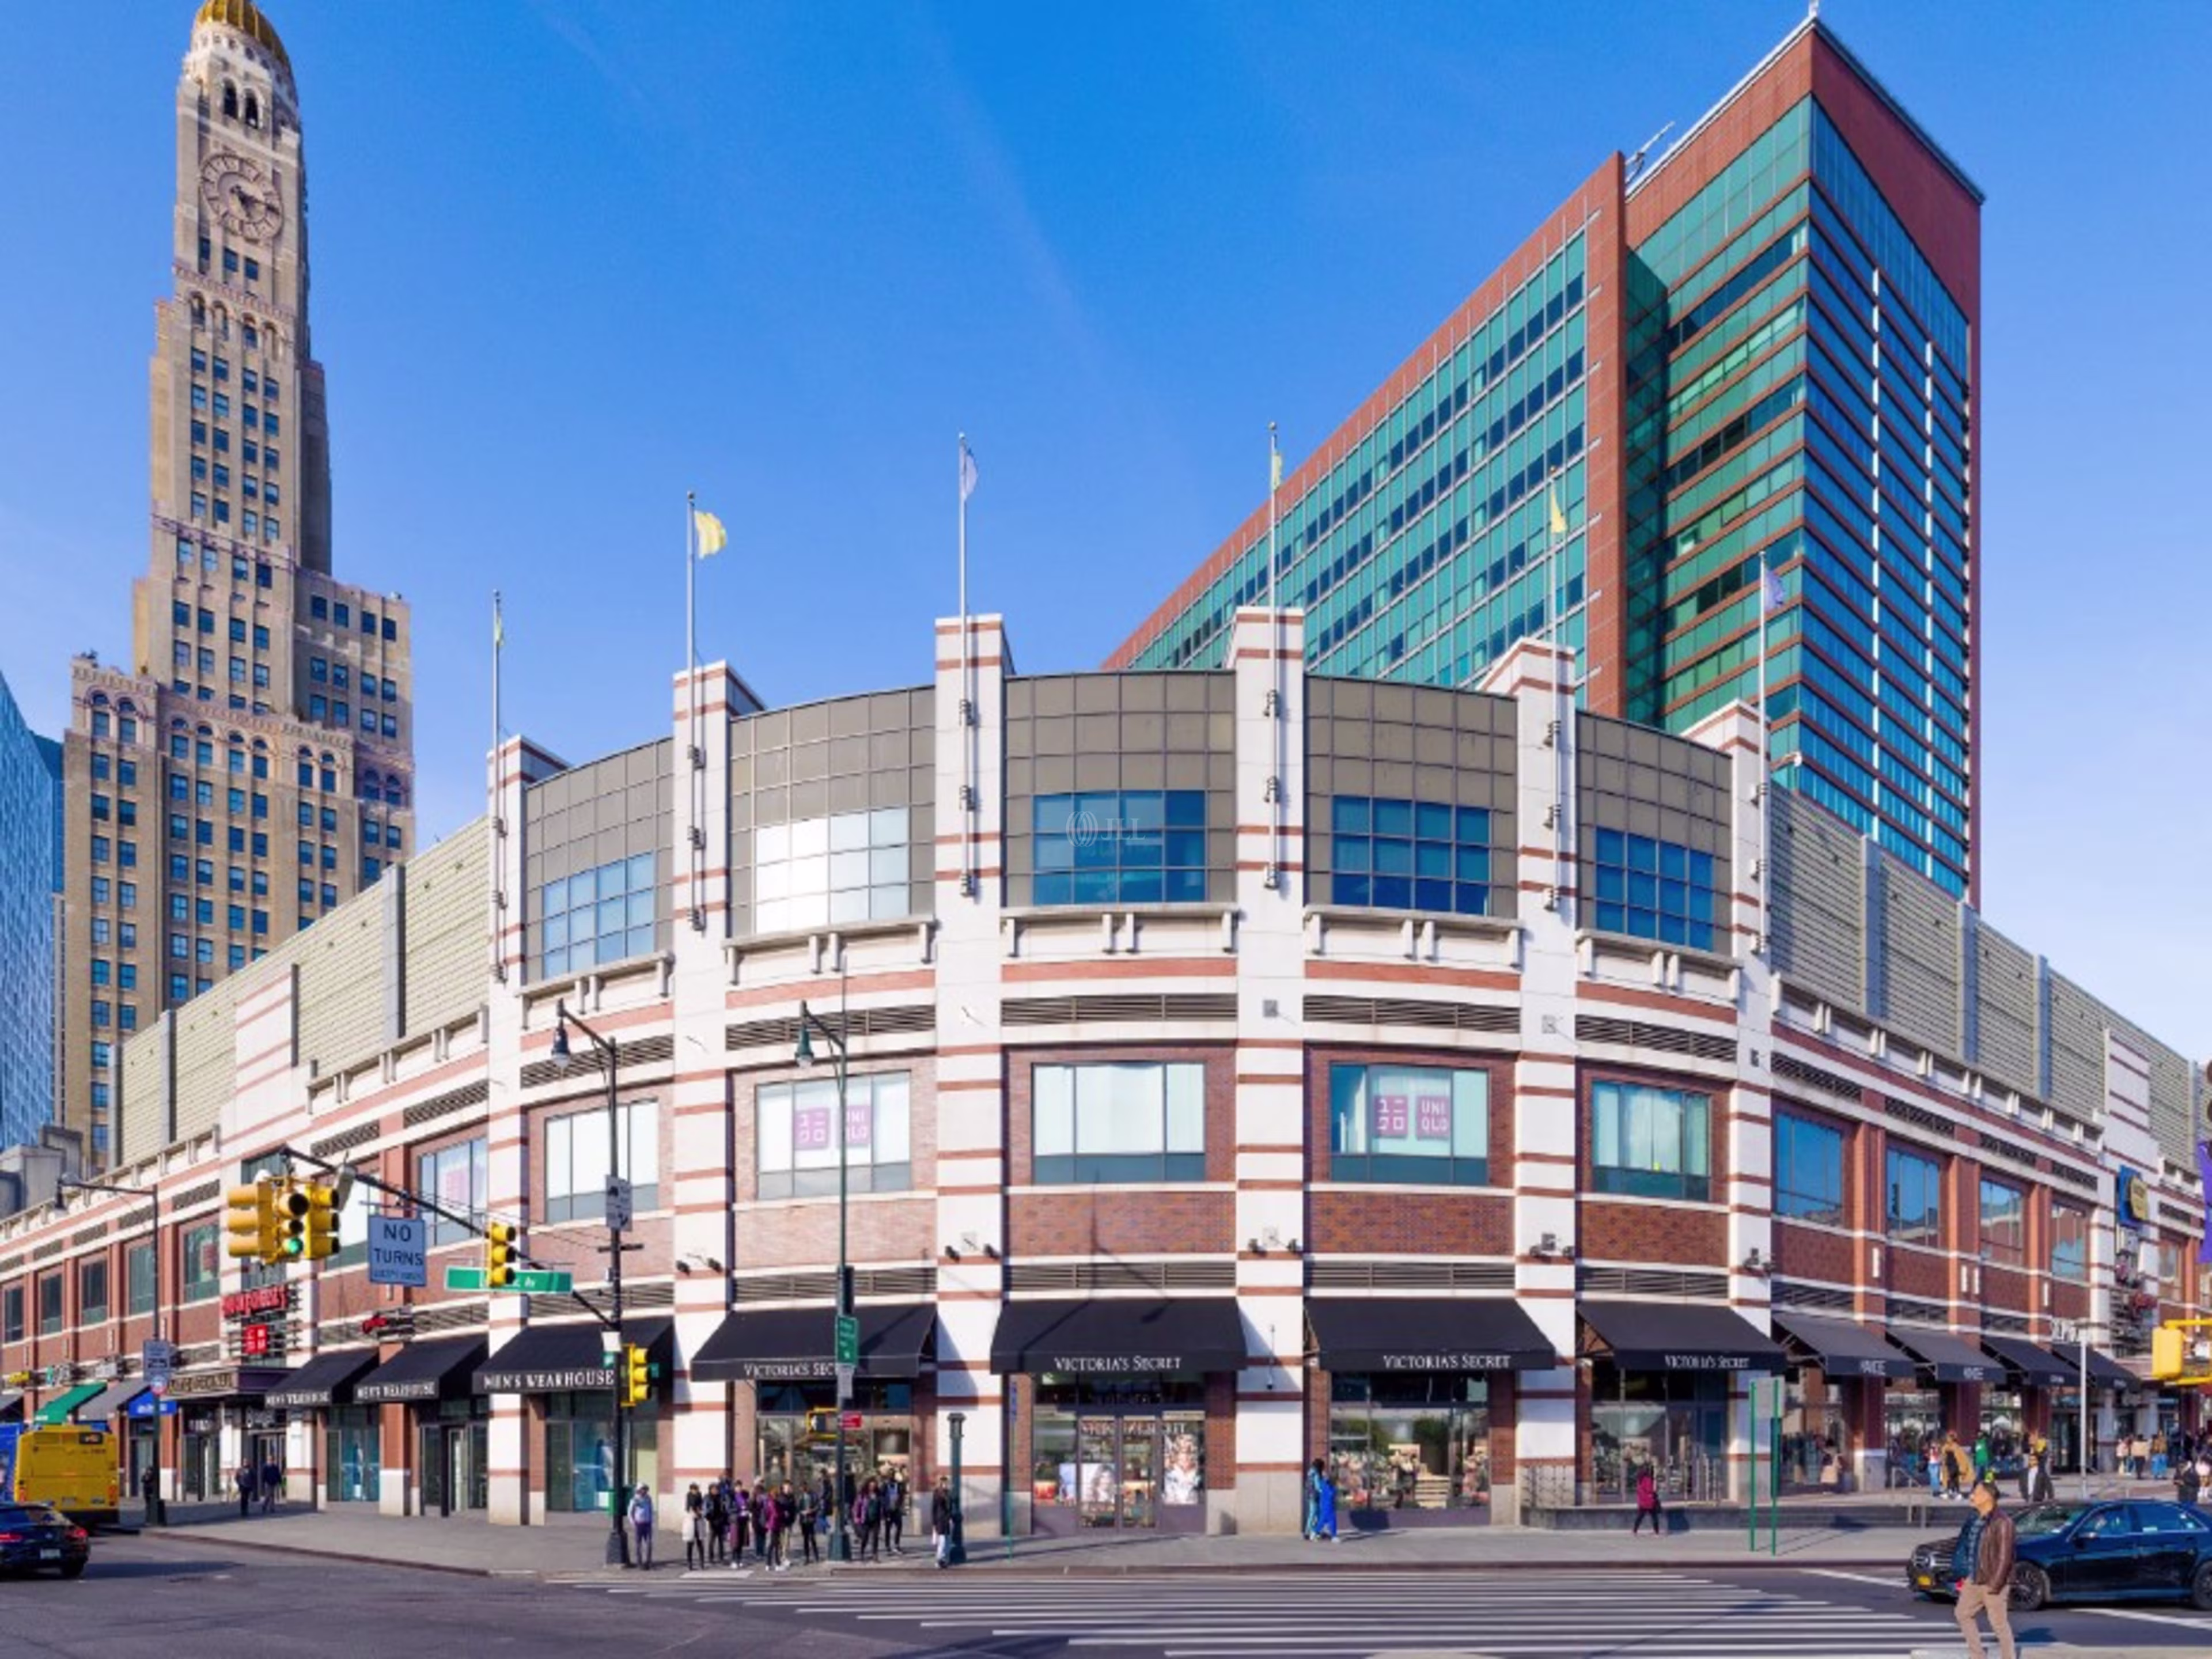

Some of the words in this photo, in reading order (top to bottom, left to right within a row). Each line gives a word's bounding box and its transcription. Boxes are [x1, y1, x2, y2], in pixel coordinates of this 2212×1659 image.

[1421, 1099, 1445, 1115] UNI
[383, 1222, 412, 1242] NO
[373, 1248, 423, 1266] TURNS
[1054, 1356, 1130, 1371] VICTORIA'S
[1133, 1355, 1181, 1371] SECRET
[1382, 1355, 1459, 1369] VICTORIA'S
[1461, 1353, 1512, 1369] SECRET
[526, 1369, 615, 1388] WEARHOUSE
